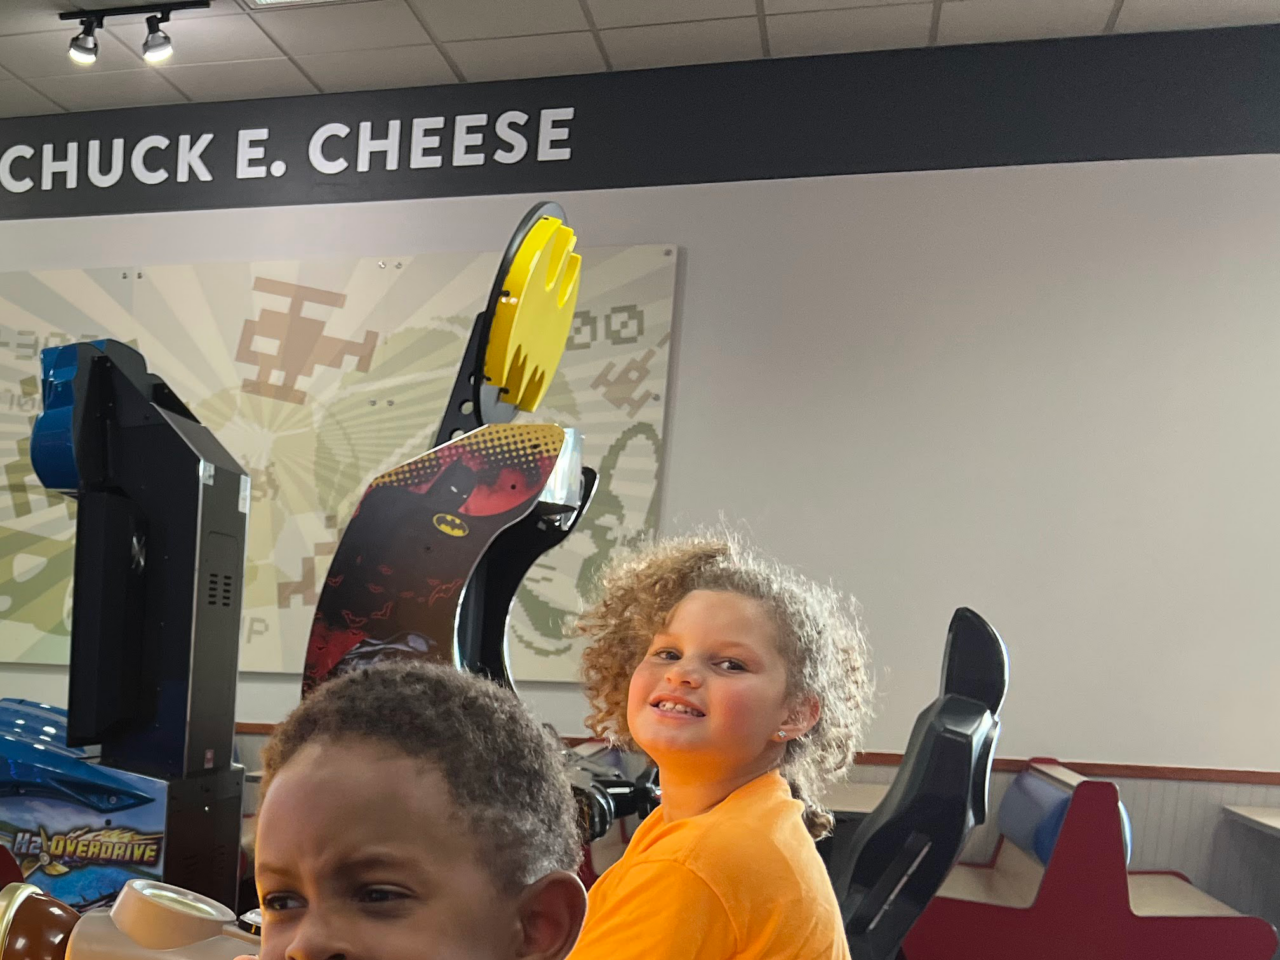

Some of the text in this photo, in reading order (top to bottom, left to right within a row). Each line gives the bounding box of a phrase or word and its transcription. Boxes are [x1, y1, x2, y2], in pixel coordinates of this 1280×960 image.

[236, 128, 287, 179] E.
[308, 108, 575, 175] CHEESE
[49, 835, 158, 862] OVERDRIVE
